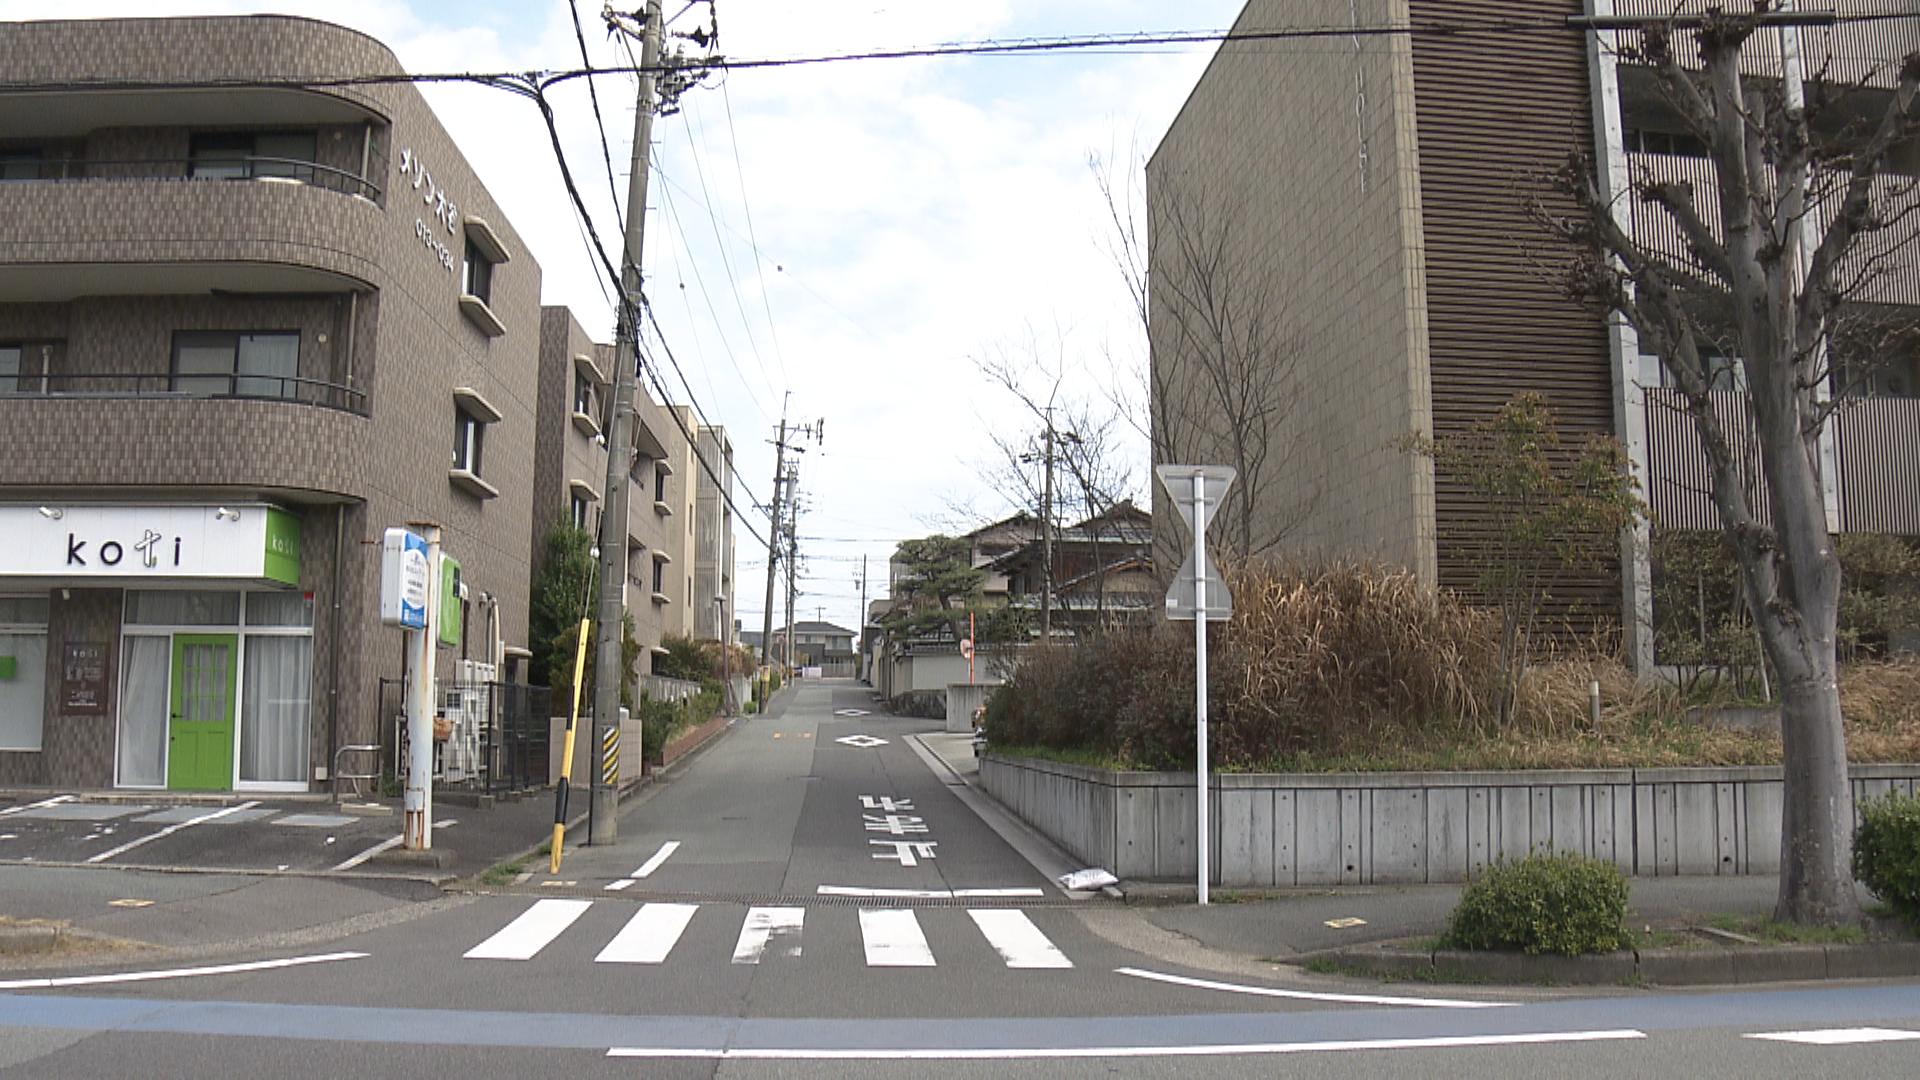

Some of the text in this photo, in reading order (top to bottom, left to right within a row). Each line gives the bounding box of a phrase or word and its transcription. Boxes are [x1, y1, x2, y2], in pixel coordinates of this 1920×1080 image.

[66, 529, 182, 569] koti
[858, 794, 938, 866] 止まれ
